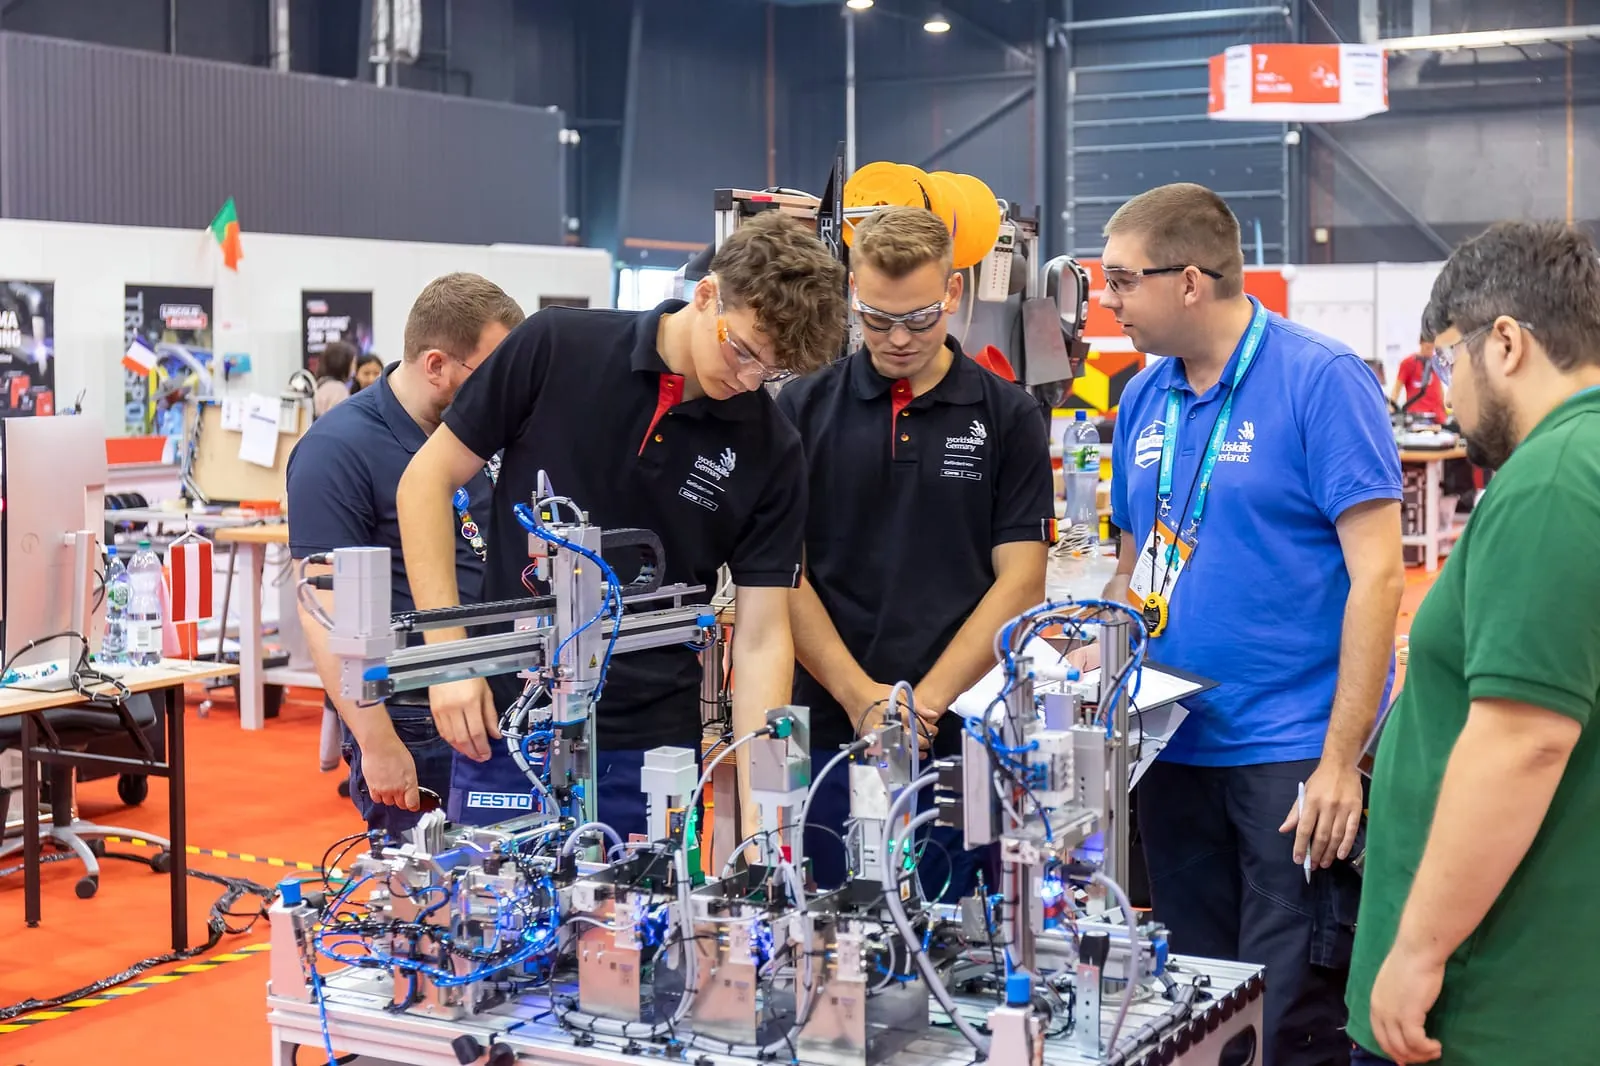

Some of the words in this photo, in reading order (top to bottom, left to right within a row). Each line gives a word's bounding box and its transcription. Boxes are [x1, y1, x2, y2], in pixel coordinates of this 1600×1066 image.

[945, 442, 977, 452] Germany
[694, 460, 722, 481] Germany
[470, 793, 530, 808] FESTO
